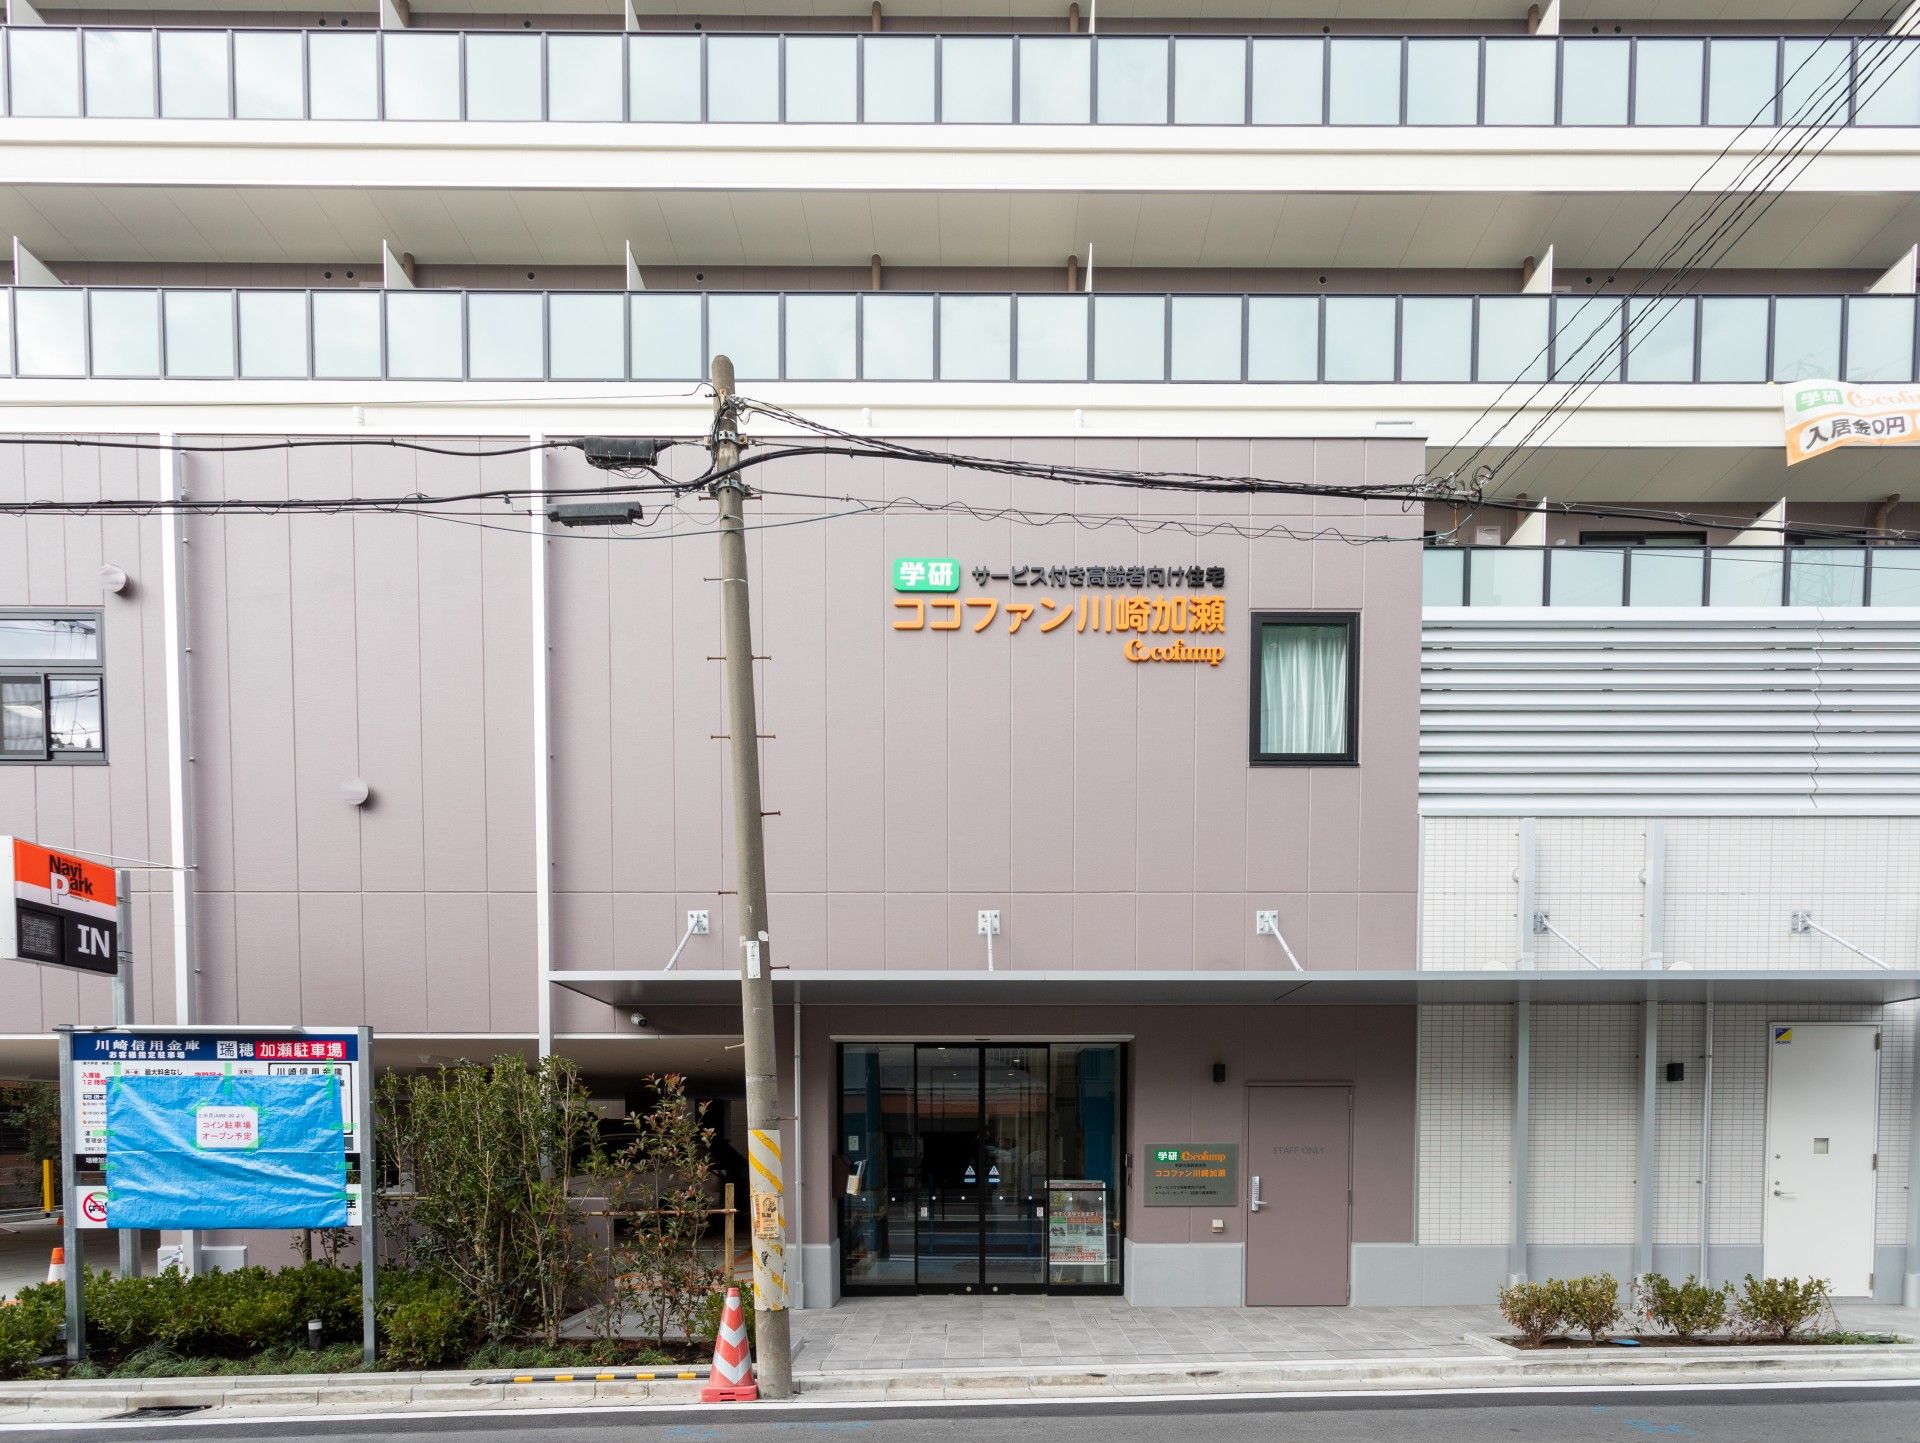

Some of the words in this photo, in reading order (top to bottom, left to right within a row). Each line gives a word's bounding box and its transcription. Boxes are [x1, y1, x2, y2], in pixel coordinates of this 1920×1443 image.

[900, 561, 953, 586] 学研
[972, 565, 1225, 588] サービス付き高齢者向け住宅
[893, 595, 1225, 633] ココファン川崎加瀬
[49, 855, 82, 880] Navi
[50, 871, 94, 905] Park
[77, 923, 110, 958] IN
[95, 1039, 201, 1051] 川崎信用金庫
[260, 1042, 343, 1058] 加瀬駐車場
[202, 1121, 251, 1129] コイン駐車場
[202, 1132, 252, 1140] オープン予定
[1157, 1151, 1178, 1160] 学研
